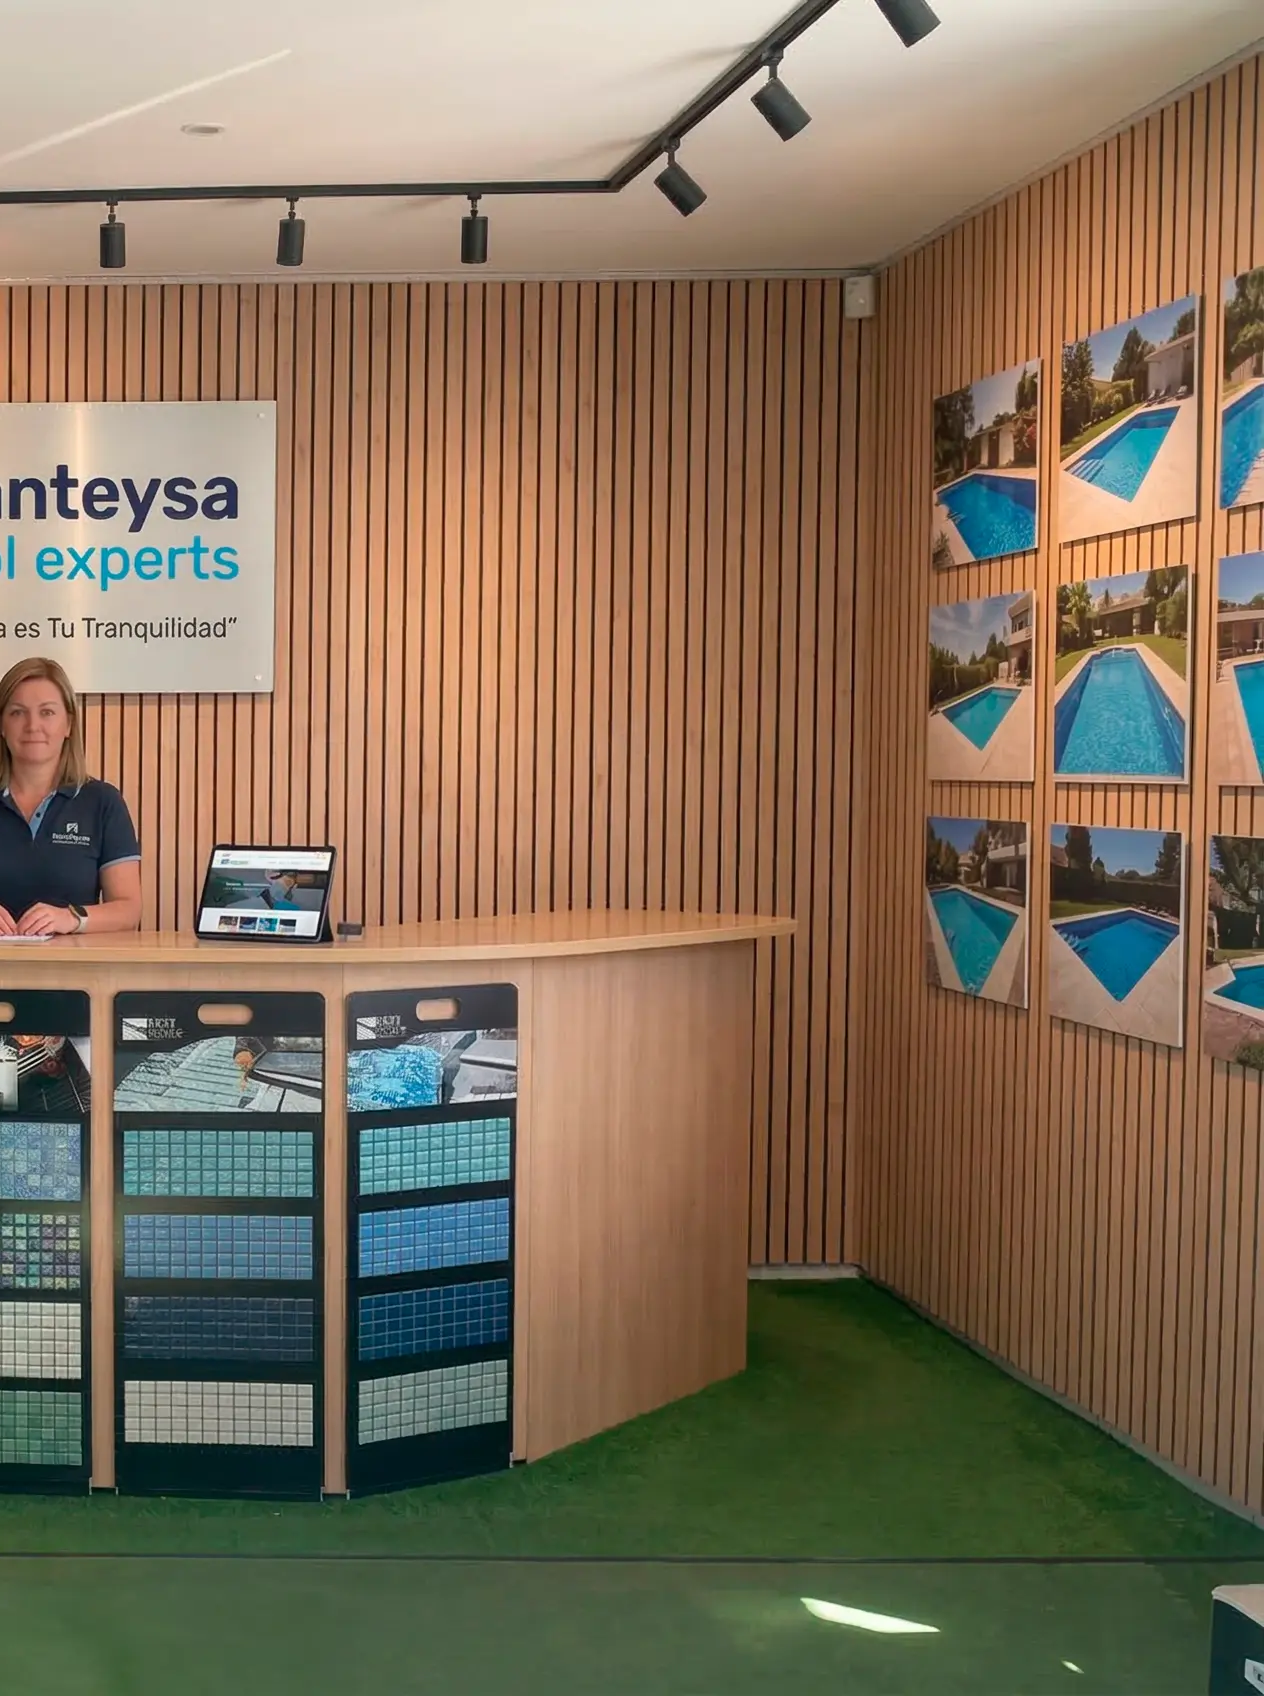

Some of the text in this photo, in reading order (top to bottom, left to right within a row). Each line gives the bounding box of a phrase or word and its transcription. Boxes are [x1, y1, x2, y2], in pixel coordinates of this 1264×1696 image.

[34, 535, 240, 592] experts
[14, 622, 41, 639] es
[47, 617, 75, 639] Tu
[81, 616, 238, 644] Tranquilidad”
